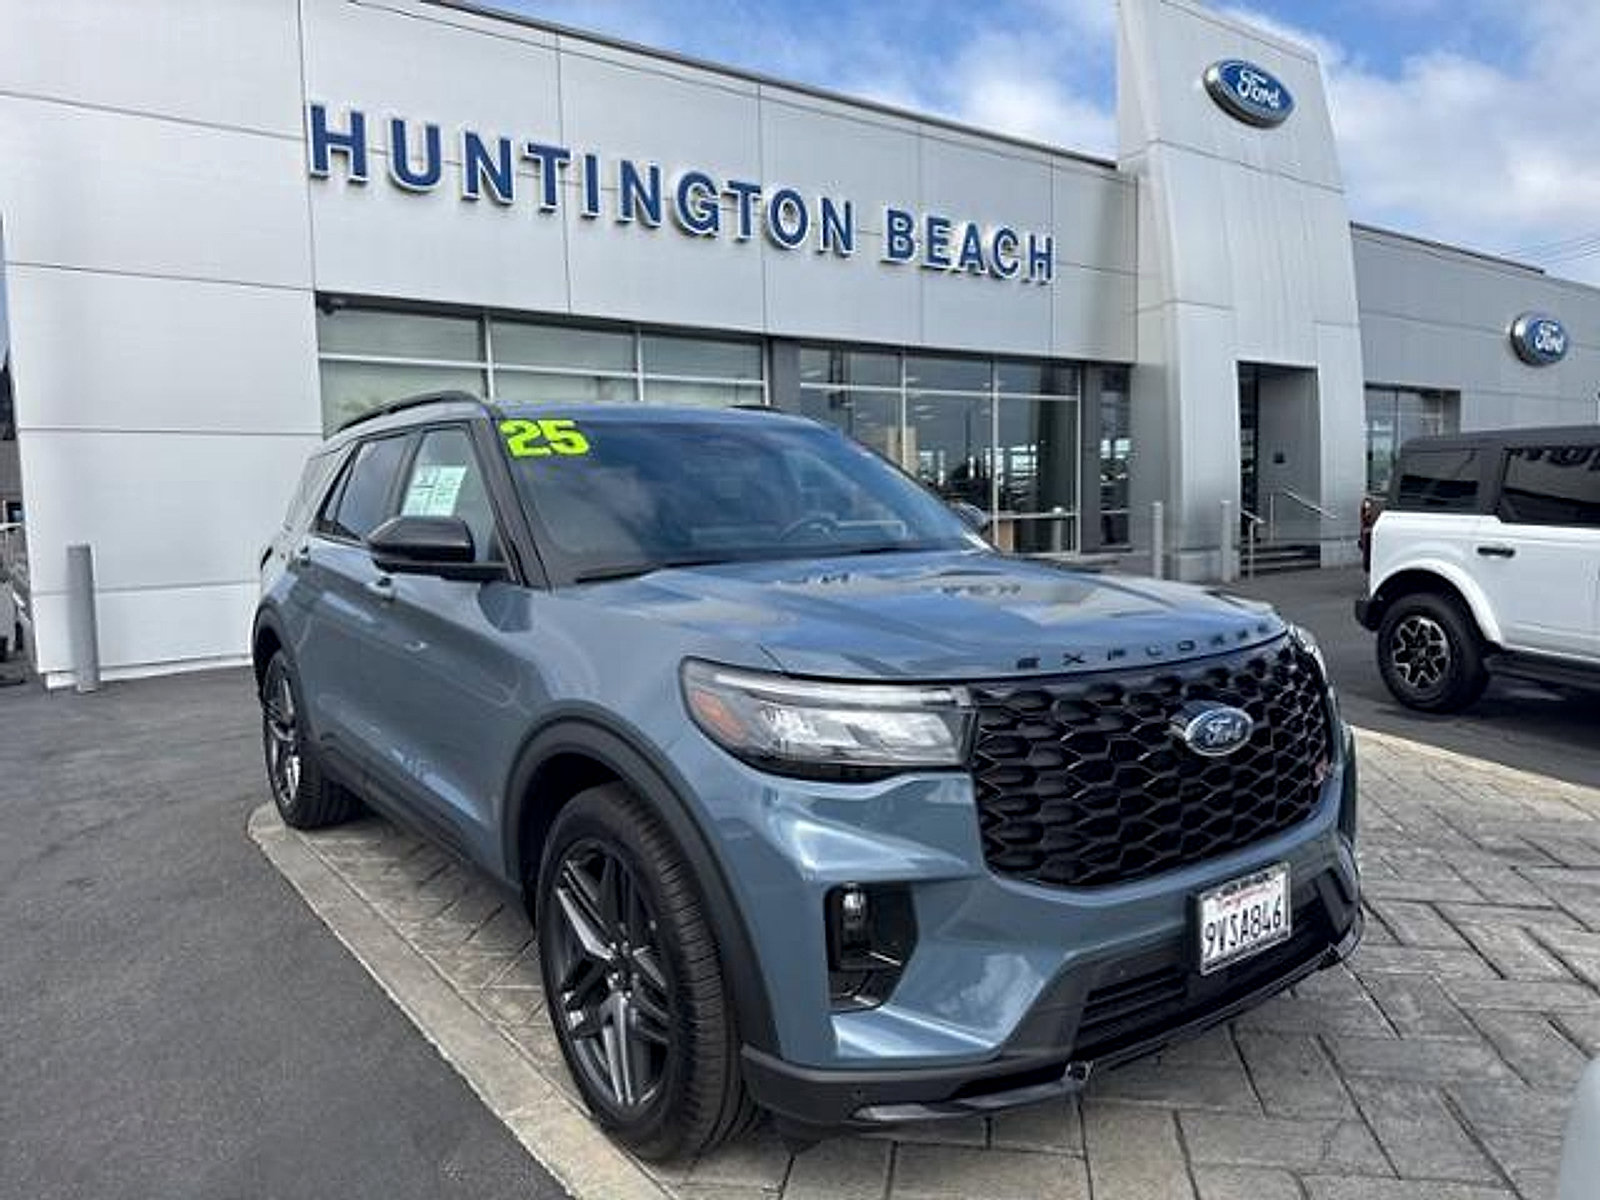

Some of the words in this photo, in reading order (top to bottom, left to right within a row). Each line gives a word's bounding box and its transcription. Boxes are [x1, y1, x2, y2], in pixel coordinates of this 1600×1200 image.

[1238, 69, 1281, 109] Ford
[309, 102, 855, 257] HUNTINGTON
[883, 207, 1054, 283] BEACH
[1534, 322, 1565, 354] Ford
[500, 419, 590, 457] 25
[1204, 716, 1243, 746] Ford
